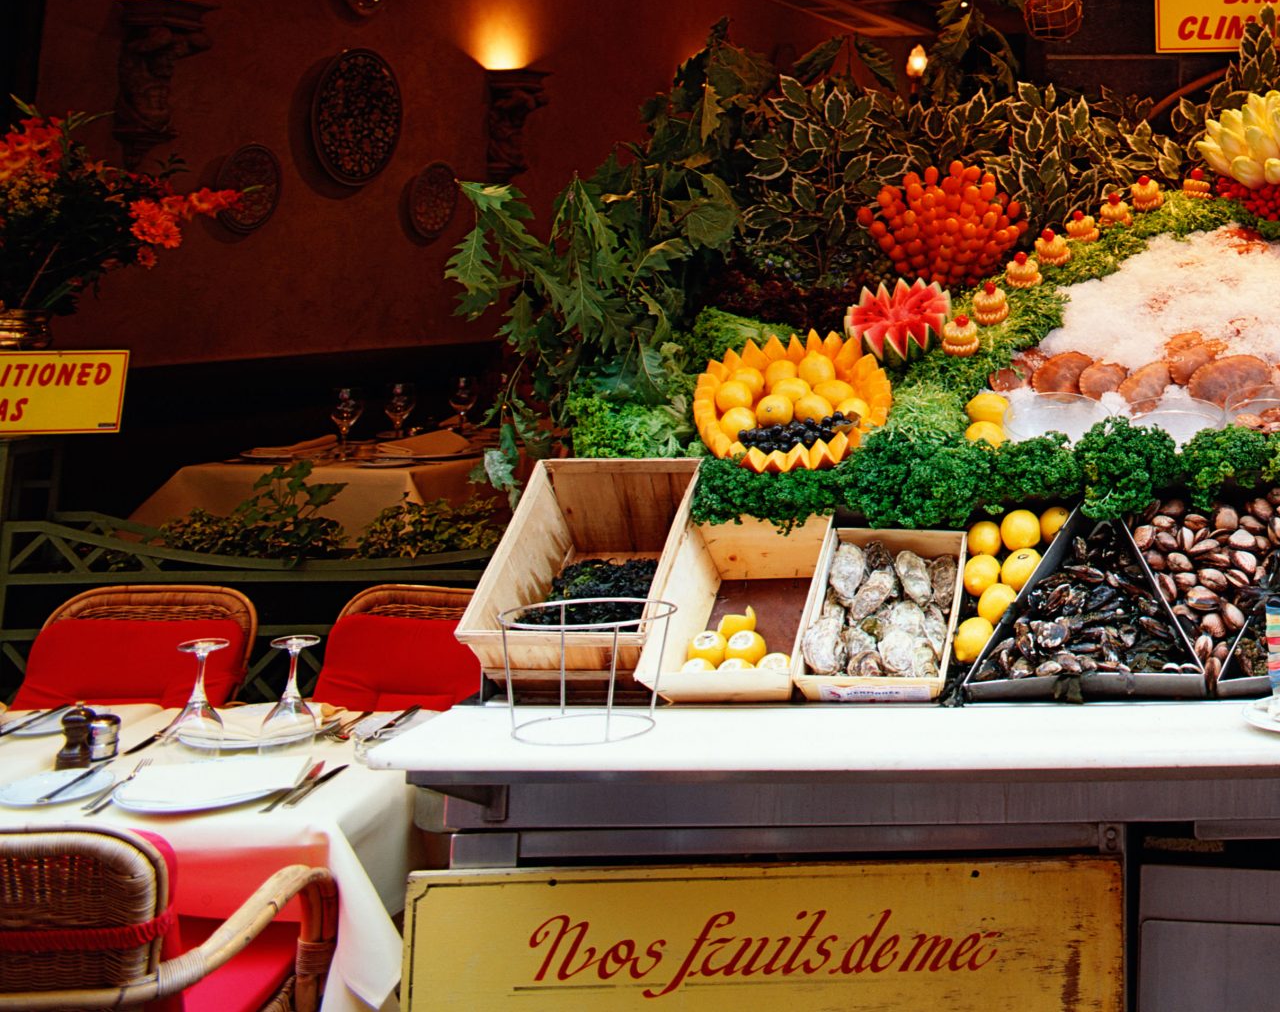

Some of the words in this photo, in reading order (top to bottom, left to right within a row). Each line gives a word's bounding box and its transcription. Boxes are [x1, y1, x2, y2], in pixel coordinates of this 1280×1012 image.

[0, 362, 112, 387] ITIONED
[529, 914, 667, 981] Nos
[642, 910, 839, 998] fruits
[828, 908, 900, 975] de
[898, 931, 1002, 972] mer
